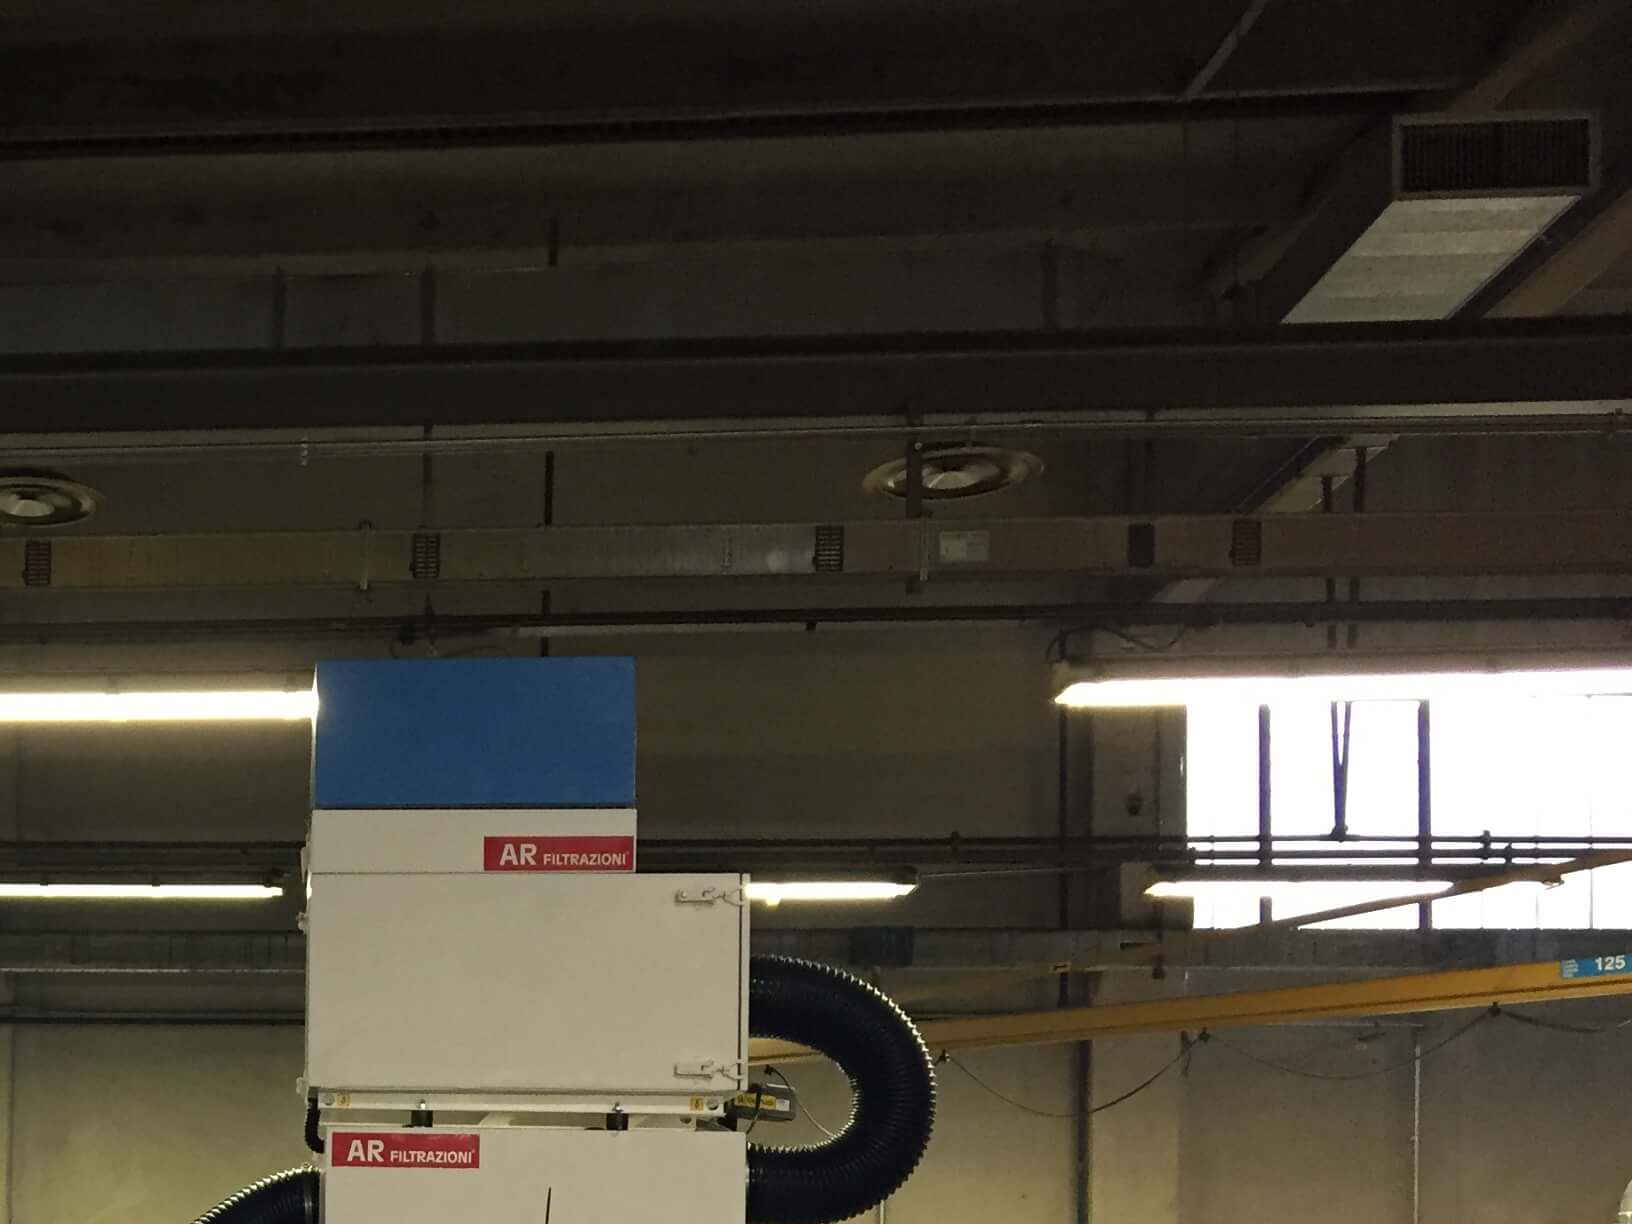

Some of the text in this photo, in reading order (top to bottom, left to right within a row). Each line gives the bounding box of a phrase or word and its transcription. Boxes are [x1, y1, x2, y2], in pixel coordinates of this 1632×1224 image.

[499, 842, 627, 866] AR FILTRAZIONI
[1594, 954, 1626, 971] 125
[346, 1138, 472, 1164] AR FILTRAZIONI
